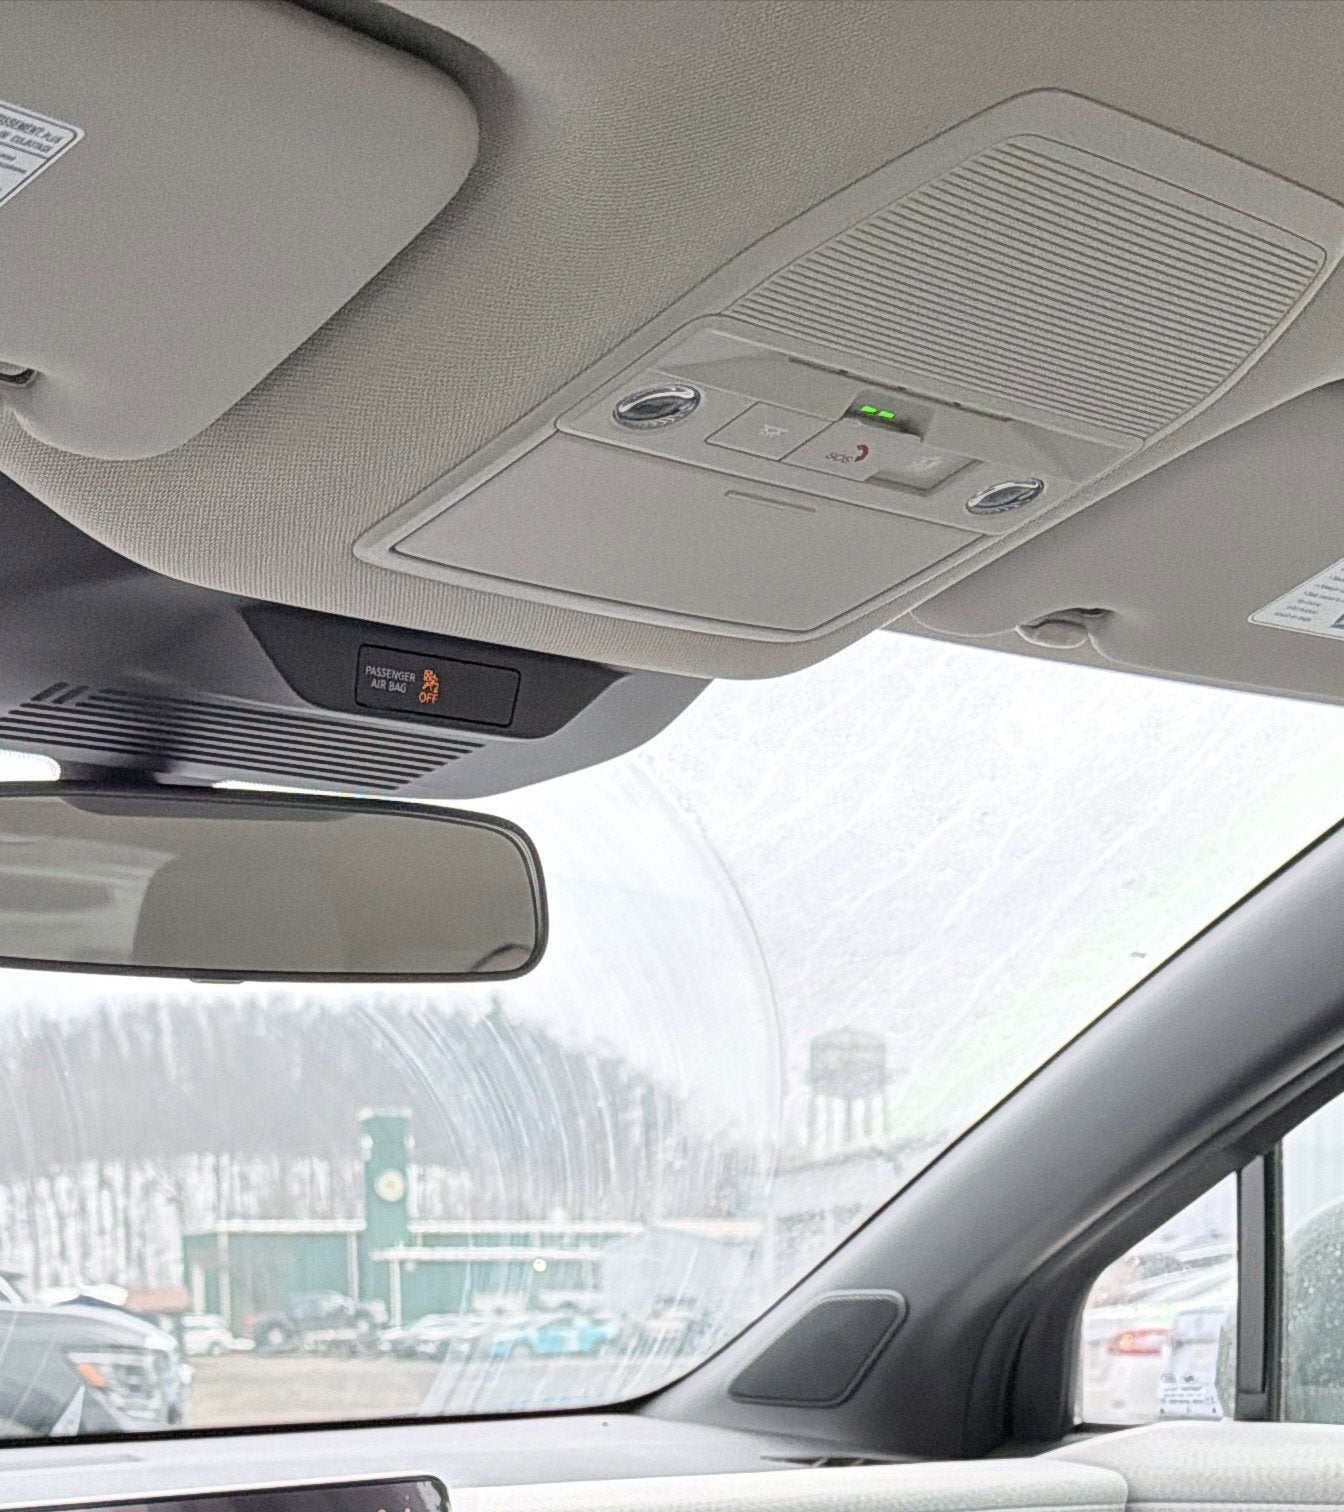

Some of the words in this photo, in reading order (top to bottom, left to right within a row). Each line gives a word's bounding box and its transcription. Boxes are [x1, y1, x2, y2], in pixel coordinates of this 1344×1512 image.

[365, 665, 416, 683] PASSENGER
[370, 678, 387, 691] AIR
[388, 680, 407, 694] BAG
[418, 691, 439, 705] OFF
